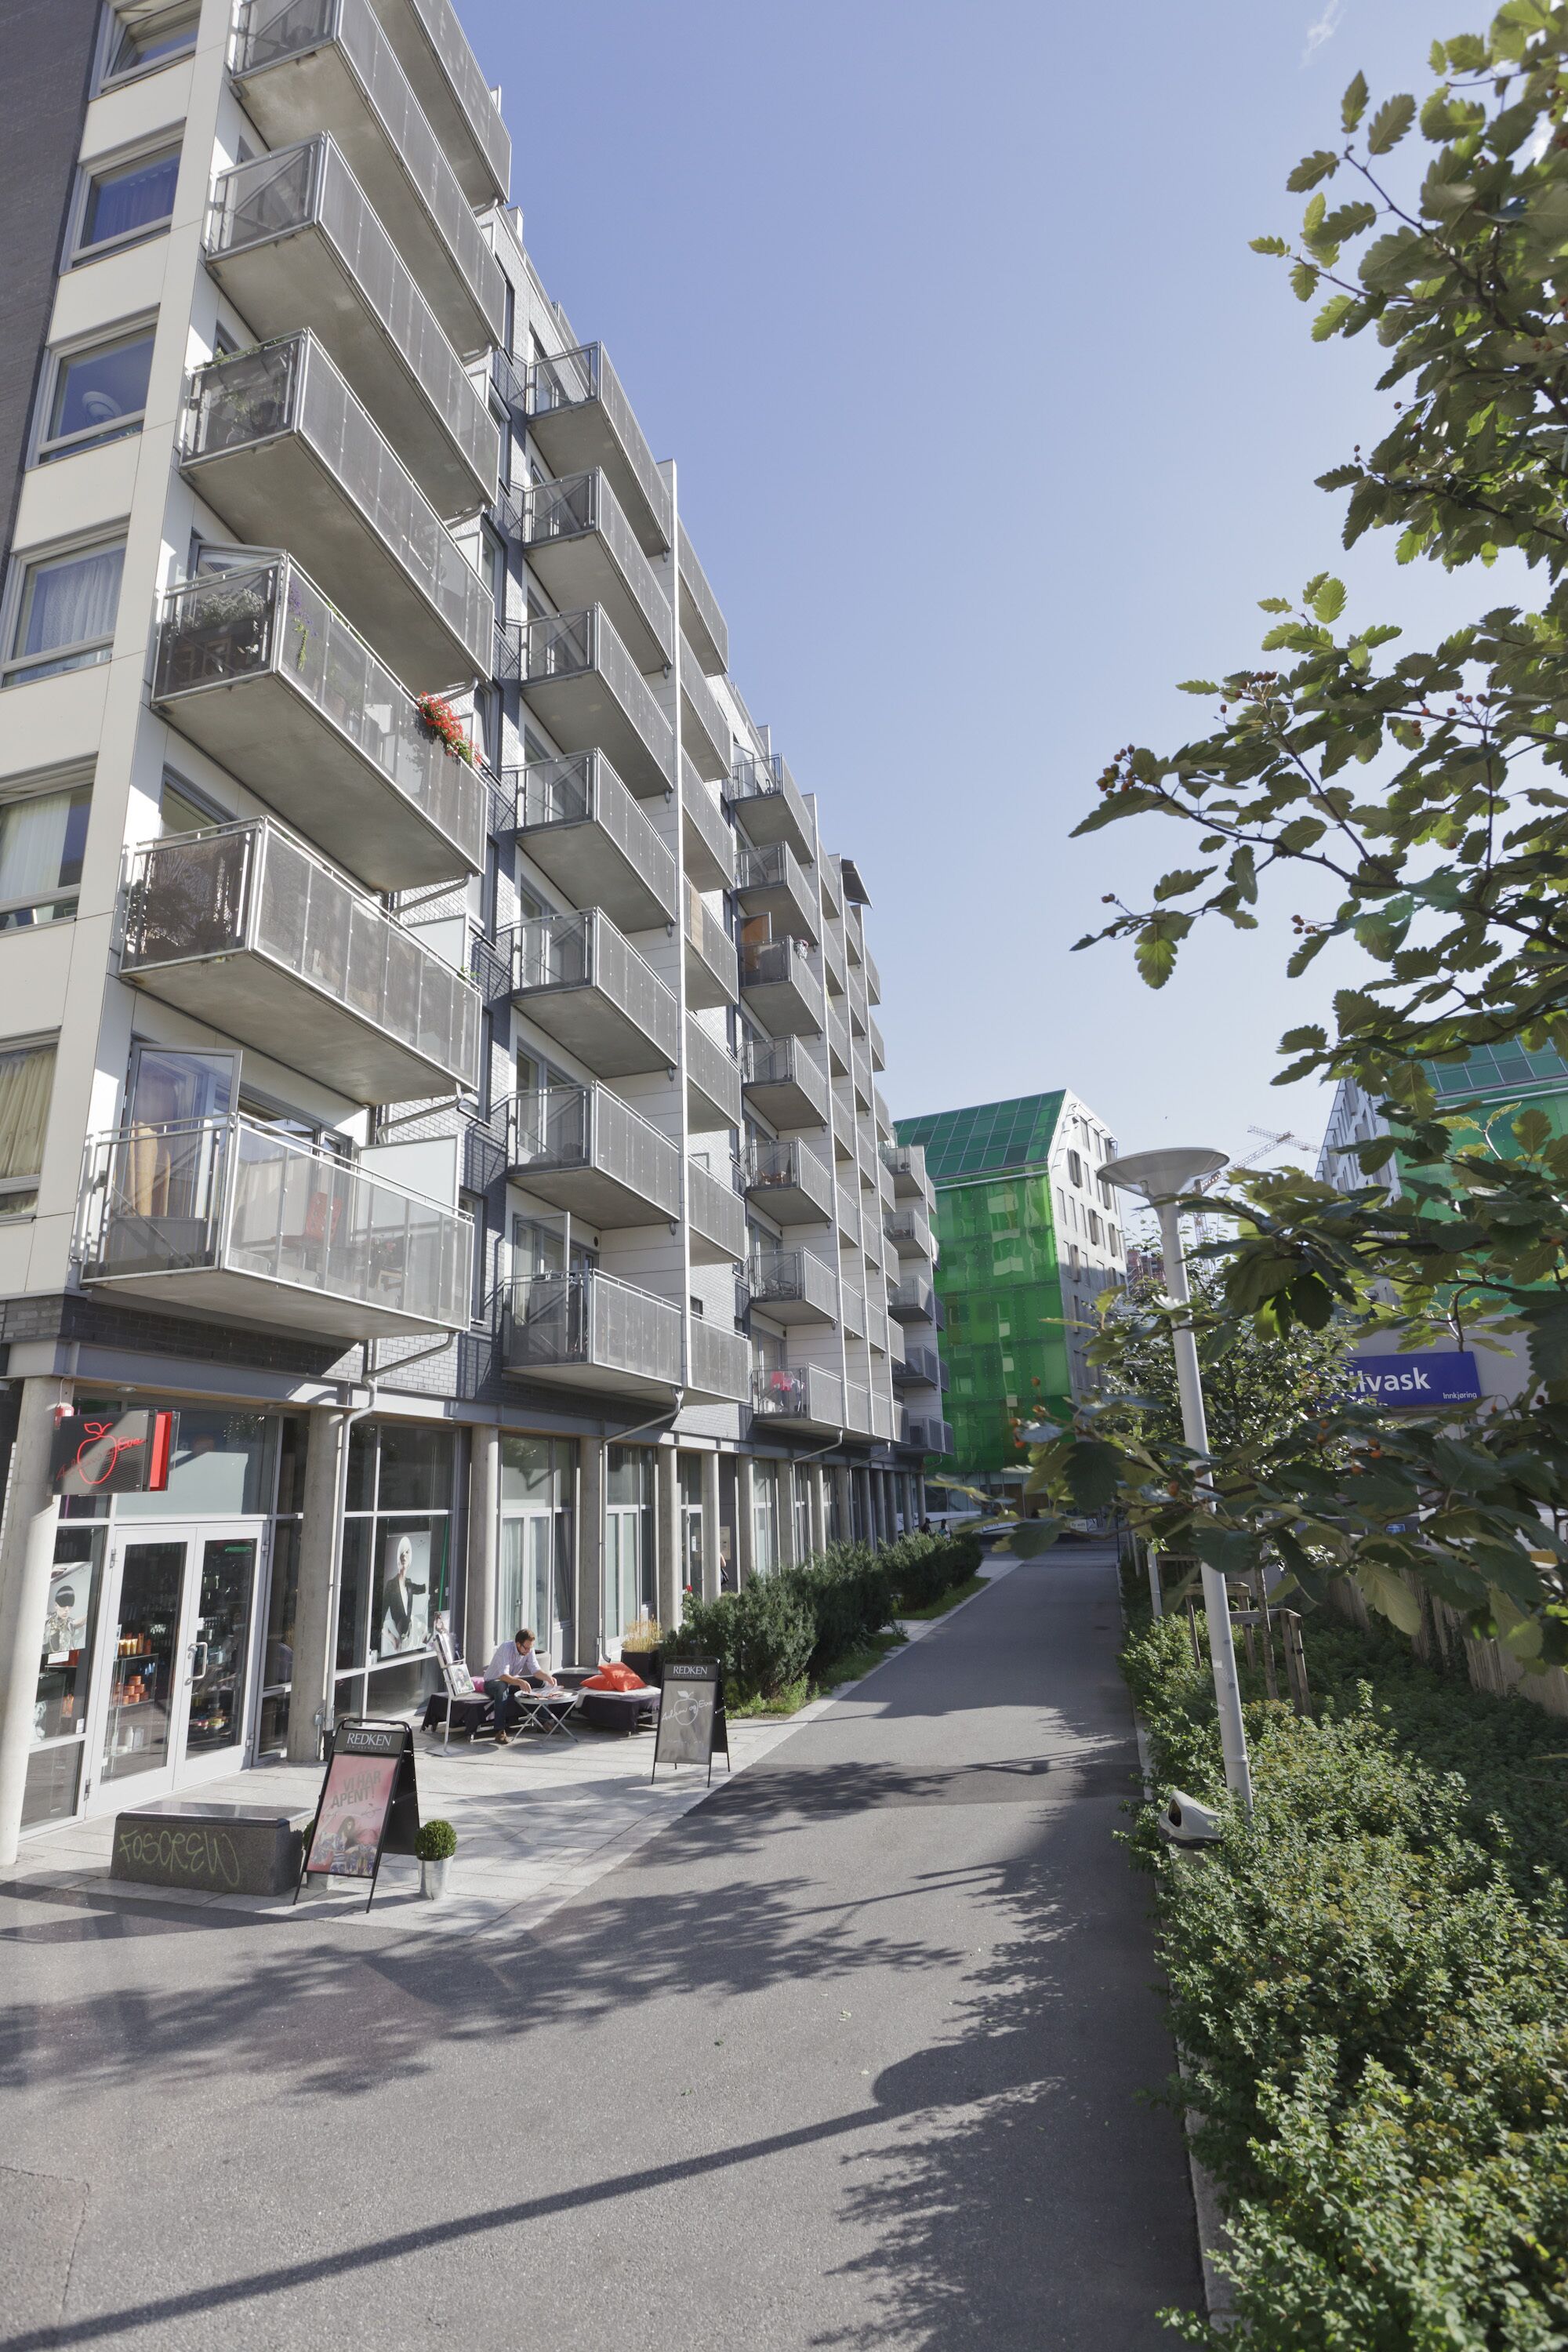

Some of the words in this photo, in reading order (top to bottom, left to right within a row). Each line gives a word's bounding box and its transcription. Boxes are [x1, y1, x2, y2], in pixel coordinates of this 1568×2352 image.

[1334, 1367, 1431, 1393] ilvask
[673, 1665, 708, 1675] REDKEN
[347, 1733, 391, 1746] REDKEN
[343, 1777, 354, 1791] VI
[358, 1770, 381, 1788] HAR
